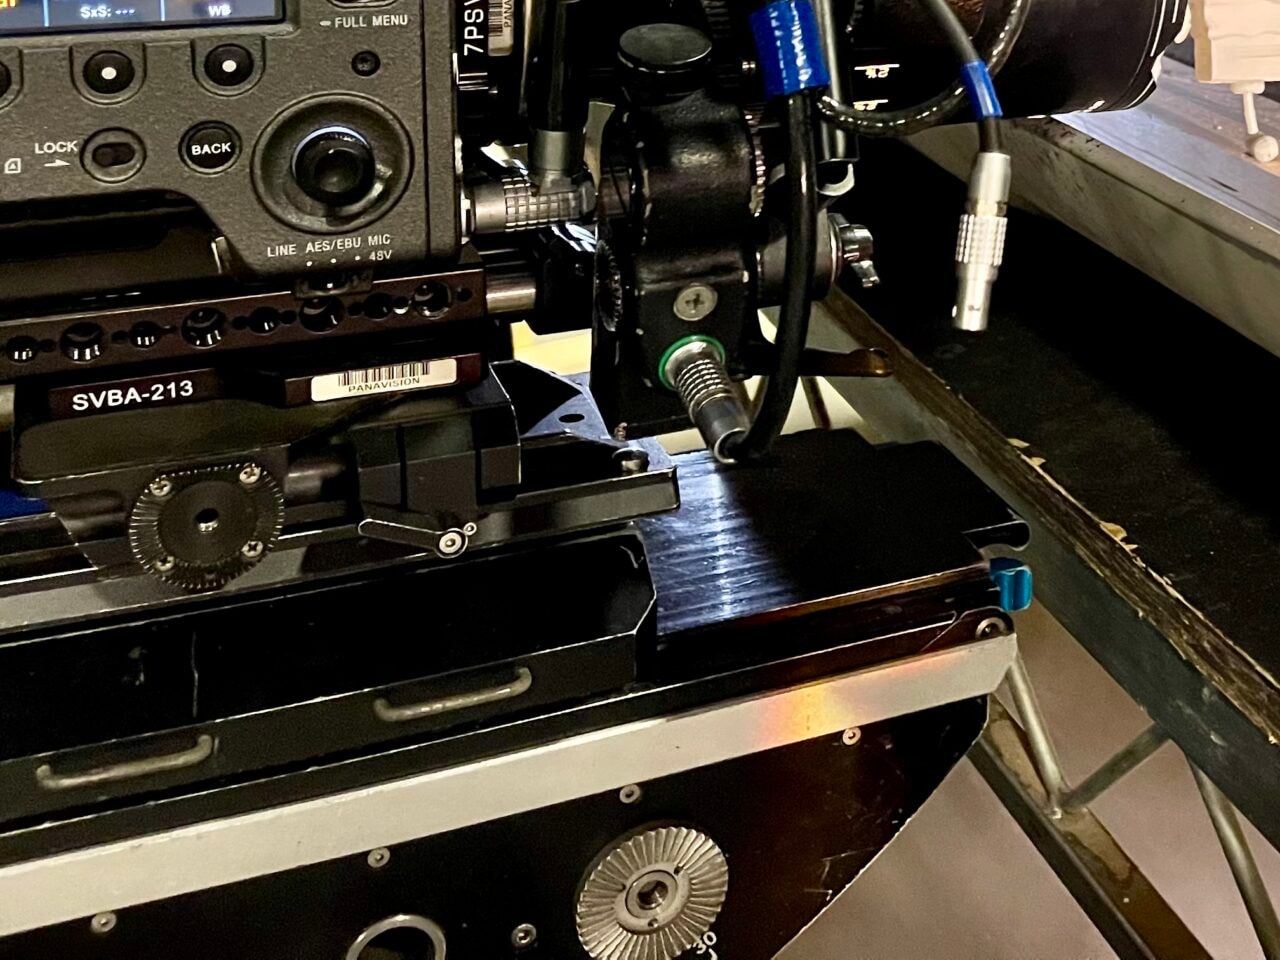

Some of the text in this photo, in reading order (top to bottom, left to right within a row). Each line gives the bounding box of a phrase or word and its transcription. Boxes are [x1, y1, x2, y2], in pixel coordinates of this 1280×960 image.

[208, 4, 232, 18] WB
[334, 14, 409, 29] FULL MENU
[34, 140, 78, 154] LOCK
[191, 142, 232, 156] BACK
[267, 233, 391, 257] LINE AES/EBU MIC
[369, 249, 393, 261] 48V
[348, 376, 421, 393] PANAVISION
[72, 380, 194, 411] SVBA-213
